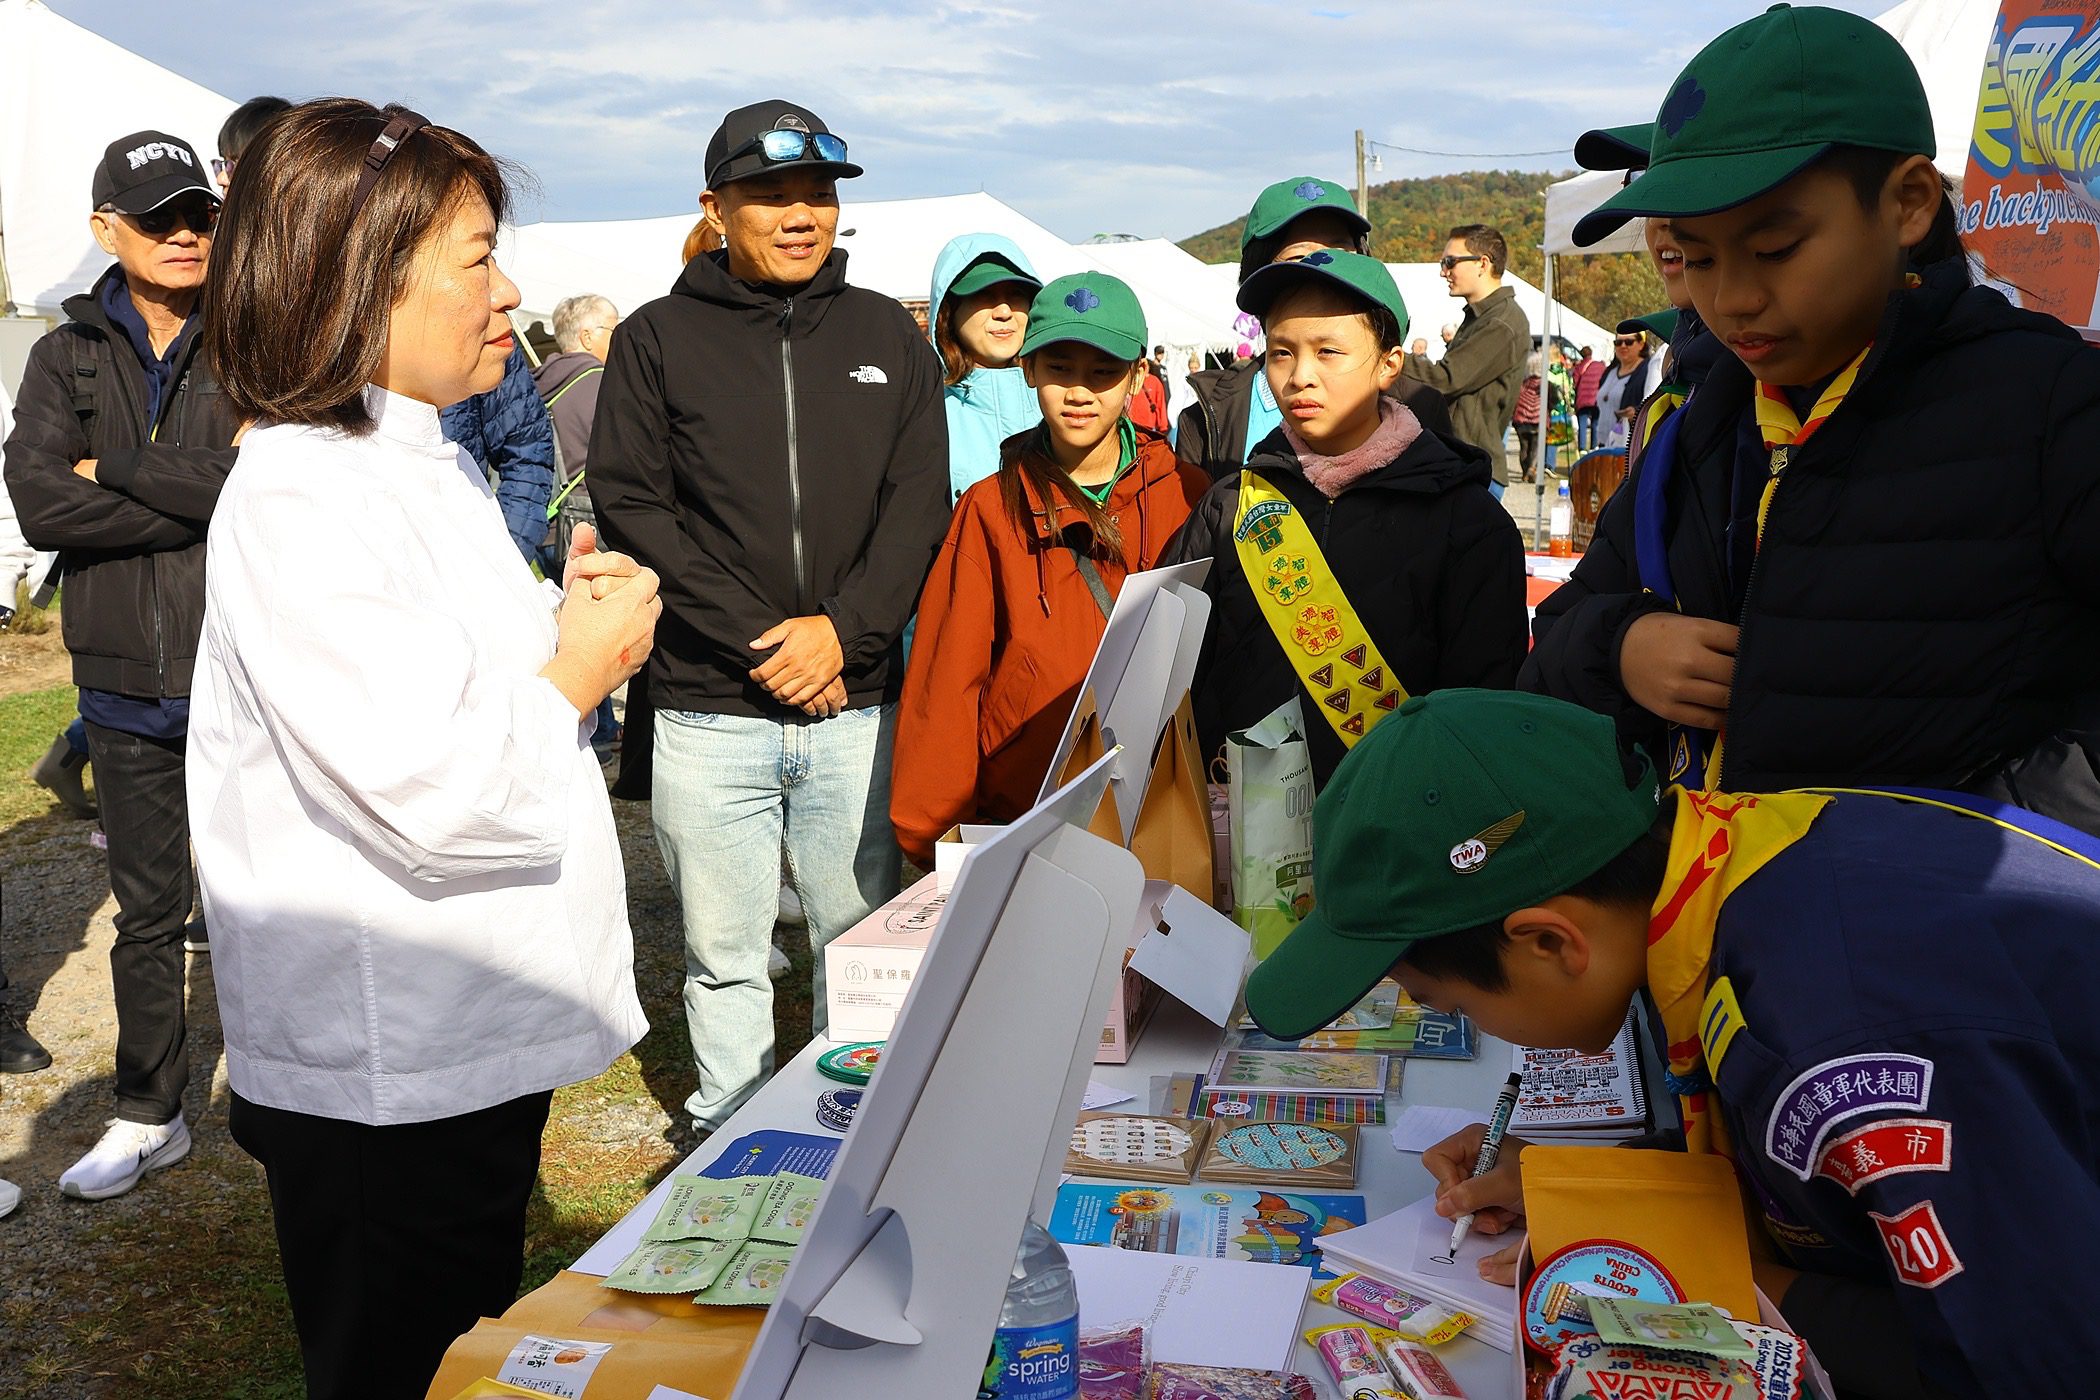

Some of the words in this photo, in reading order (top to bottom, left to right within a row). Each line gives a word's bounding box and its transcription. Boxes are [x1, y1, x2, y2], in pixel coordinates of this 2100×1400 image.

[126, 142, 193, 170] NCYU
[1263, 533, 1276, 548] 5
[1280, 765, 1309, 784] THOUSAN
[1453, 844, 1484, 864] TWA
[872, 968, 911, 981] 聖保羅
[1777, 1067, 1919, 1161] 中華民國童軍代表團
[762, 1209, 778, 1228] COOKIES
[1565, 1248, 1595, 1264] National
[1604, 1247, 1630, 1260] School
[1890, 1226, 1940, 1273] 20
[1606, 1256, 1641, 1278] CHINA
[1611, 1269, 1627, 1281] OF
[1593, 1274, 1639, 1297] SCOUTS
[1008, 1352, 1070, 1383] spring
[1608, 1349, 1711, 1371] Together
[1027, 1372, 1060, 1385] WATER
[1608, 1360, 1712, 1382] Stronger
